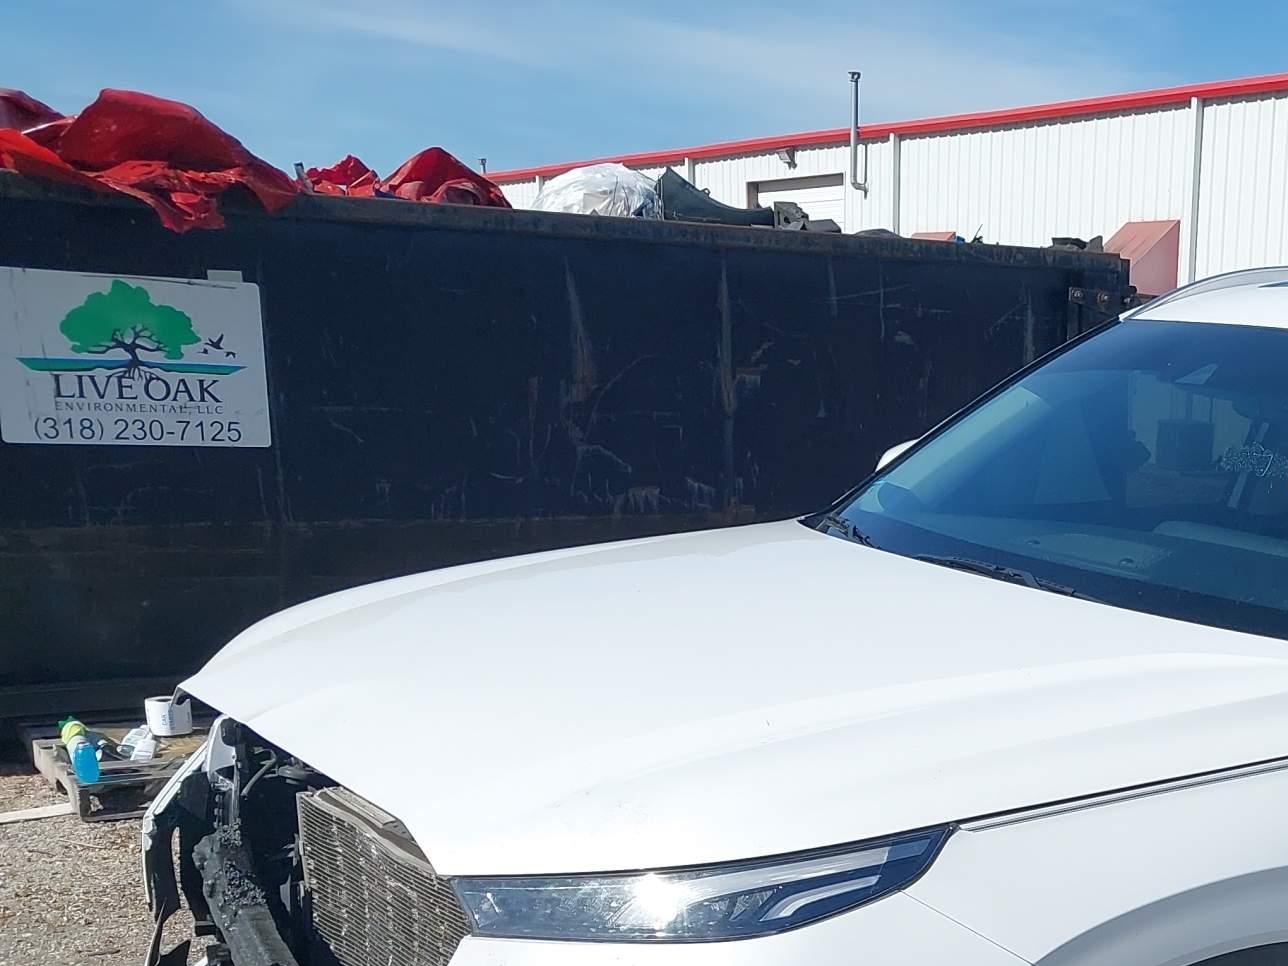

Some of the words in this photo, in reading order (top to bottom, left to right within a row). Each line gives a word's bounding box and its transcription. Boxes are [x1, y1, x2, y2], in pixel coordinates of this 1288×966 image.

[52, 373, 138, 400] LIVE
[143, 375, 223, 403] OAK
[197, 404, 224, 415] LLC
[34, 417, 104, 441] (318)
[114, 418, 242, 443] 230-7125
